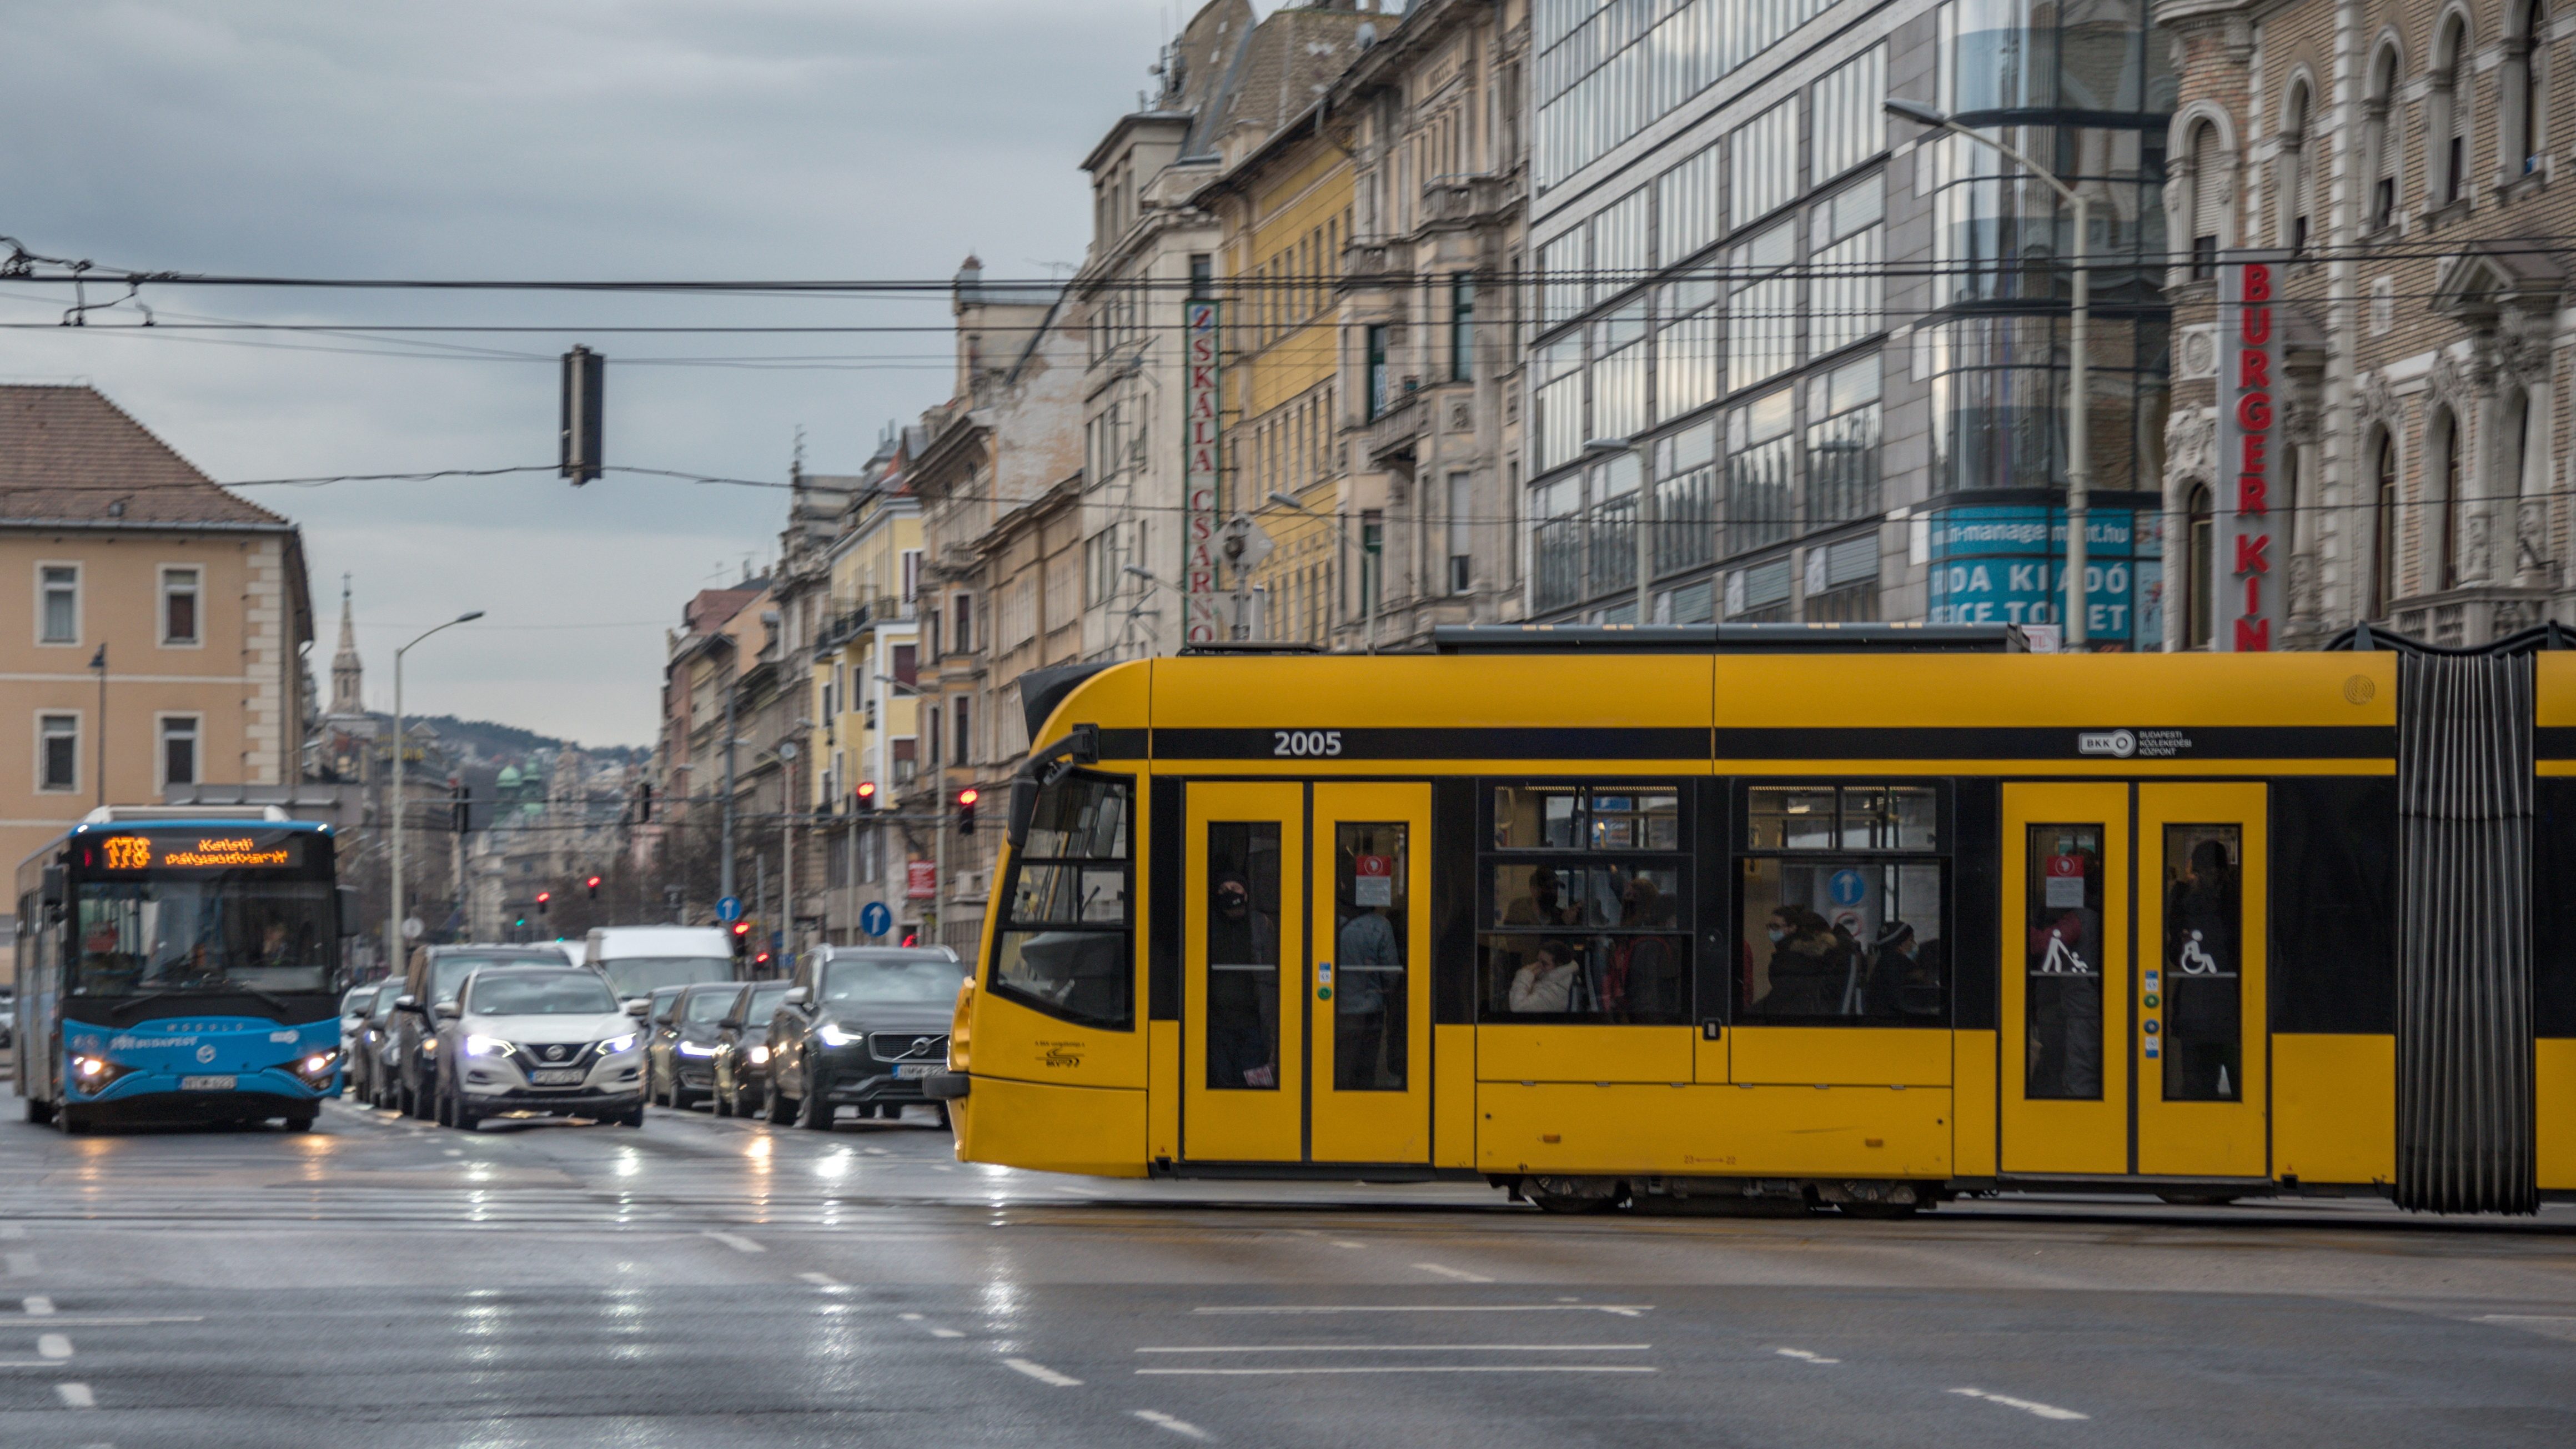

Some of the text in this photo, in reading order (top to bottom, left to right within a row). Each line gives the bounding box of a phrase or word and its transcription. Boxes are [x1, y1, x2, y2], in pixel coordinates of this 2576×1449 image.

[2237, 263, 2273, 515] BURGER
[2088, 604, 2127, 631] ET
[1274, 731, 1342, 756] 2005
[2087, 739, 2110, 748] BKK
[2140, 731, 2183, 739] BUDAPESTI
[103, 837, 150, 868] 178
[198, 838, 254, 852] Keleti
